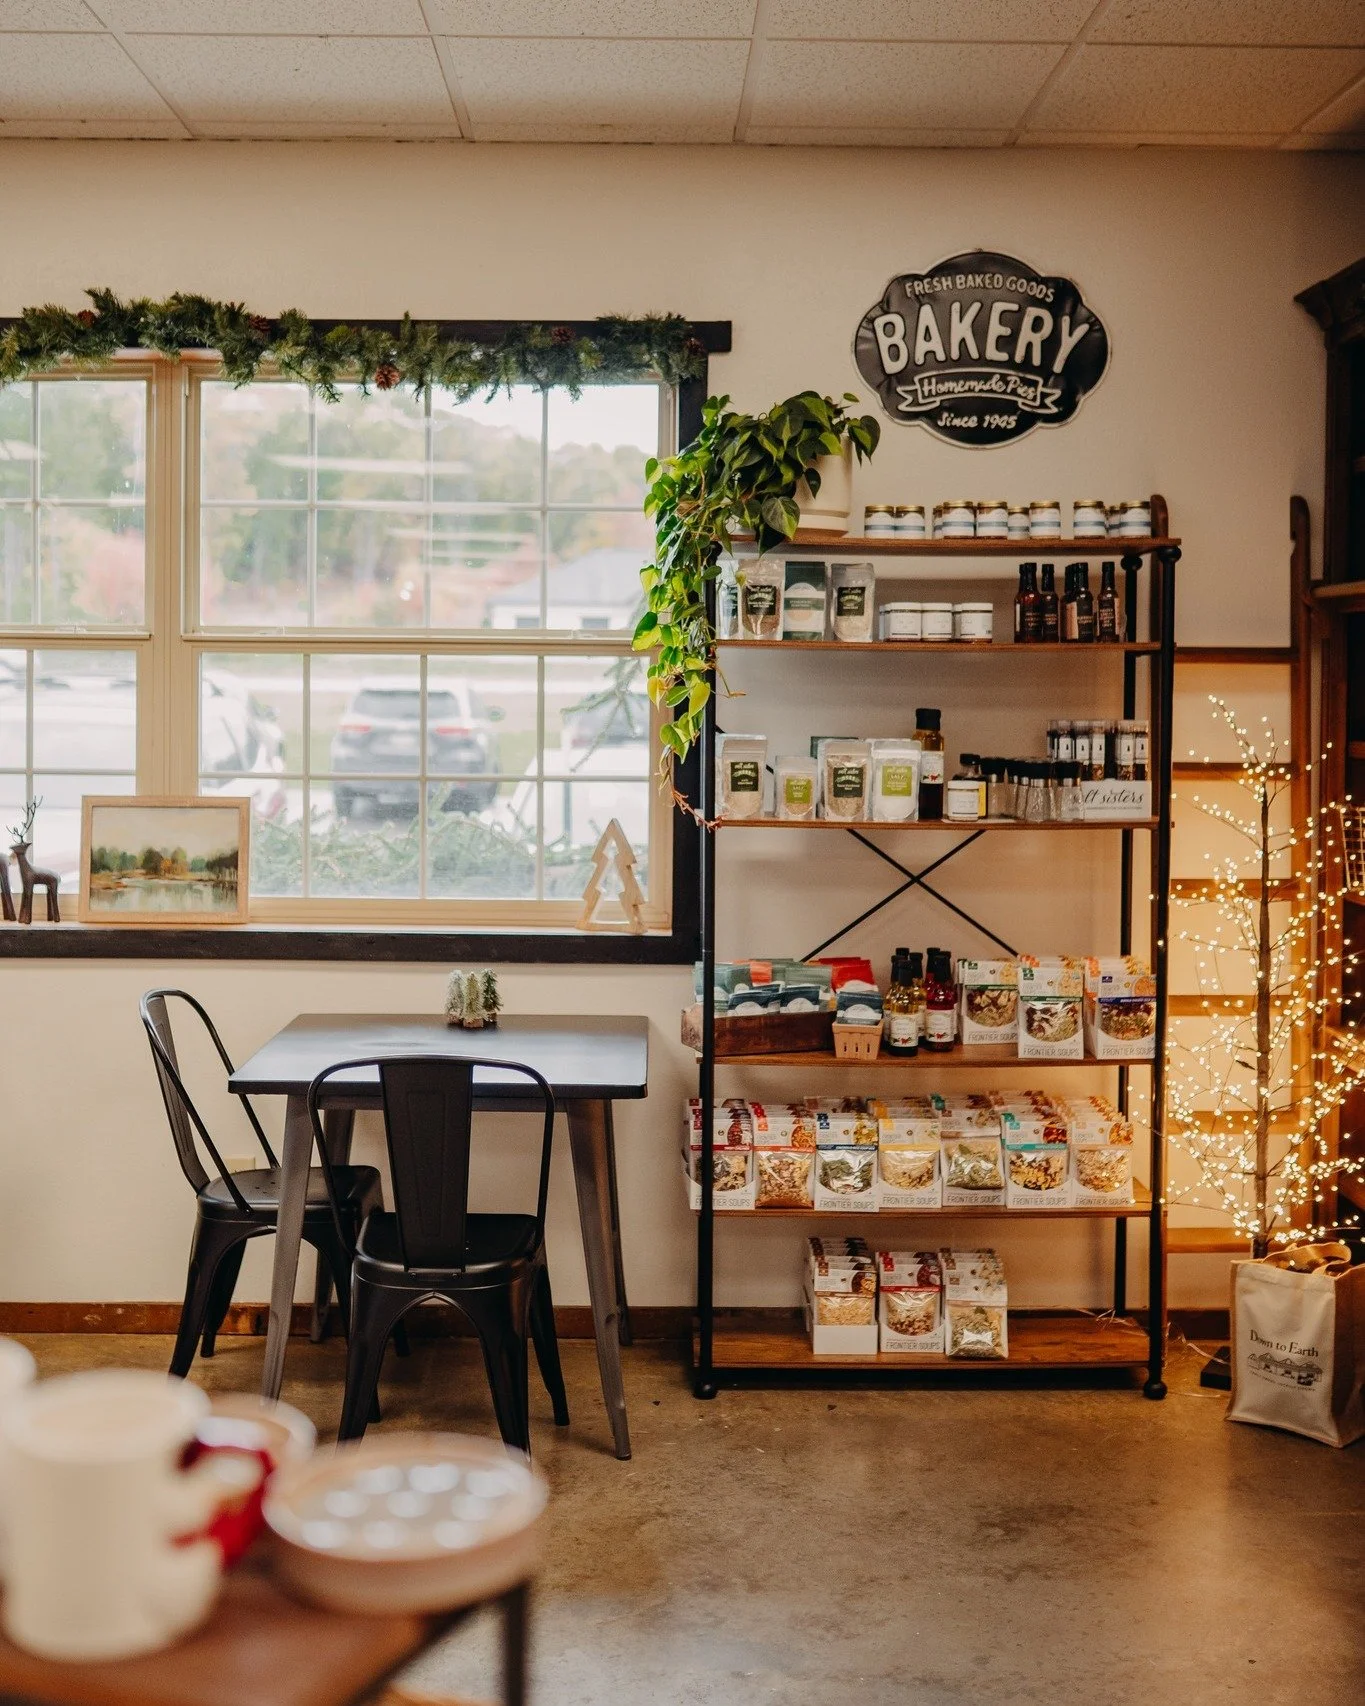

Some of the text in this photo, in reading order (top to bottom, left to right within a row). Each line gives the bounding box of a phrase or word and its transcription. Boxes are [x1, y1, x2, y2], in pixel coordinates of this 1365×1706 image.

[905, 273, 1055, 303] FRESH BAKED GOODS
[873, 301, 1090, 375] BAKERY
[937, 411, 978, 428] Since
[1101, 789, 1144, 804] sisters
[1023, 1047, 1080, 1057] FRONTIER SOUPS
[819, 1200, 875, 1209] FRONTIER SOUPS
[1276, 1342, 1287, 1352] to
[1288, 1341, 1319, 1357] Earth
